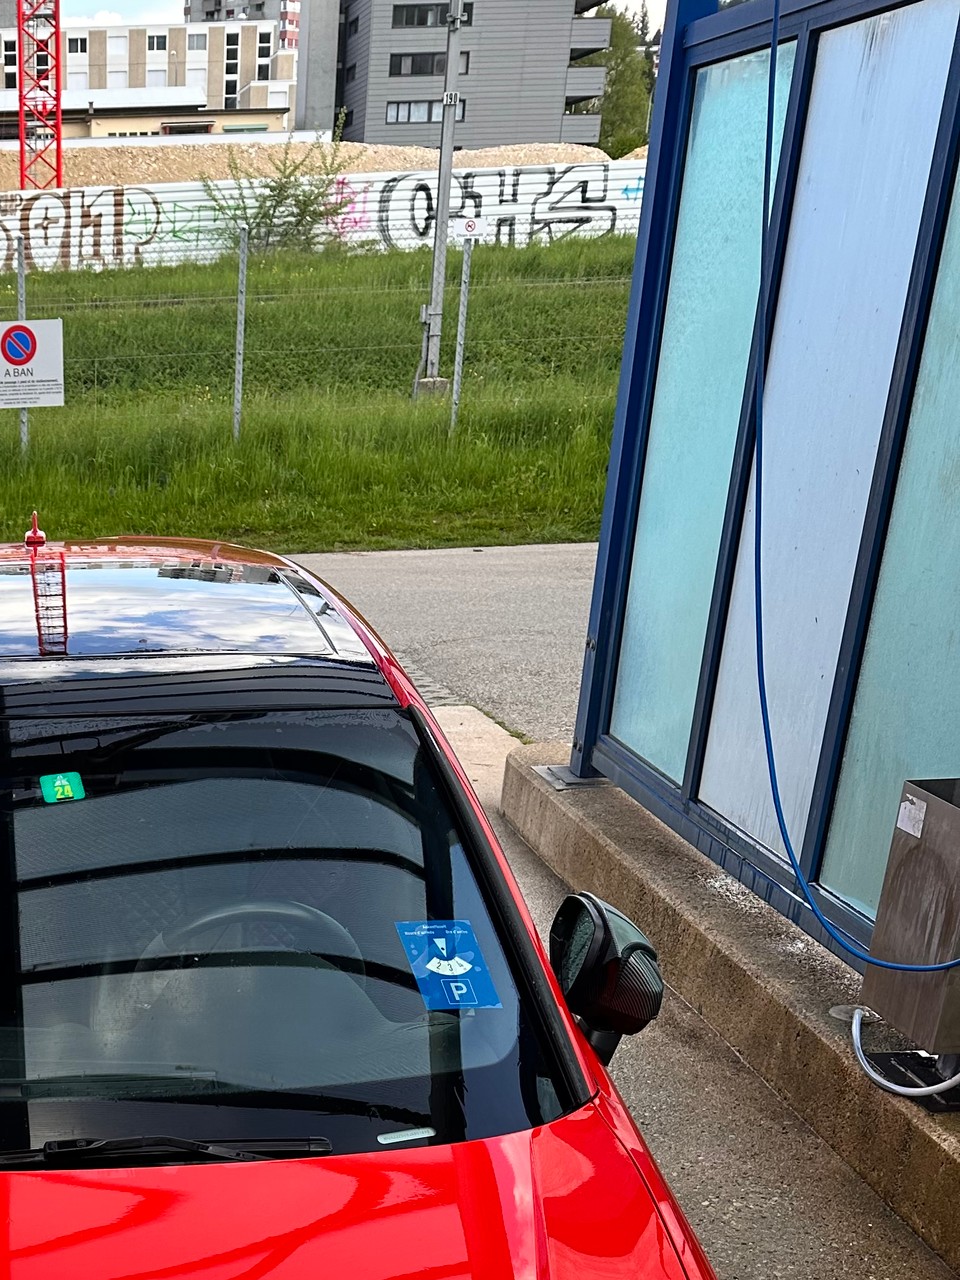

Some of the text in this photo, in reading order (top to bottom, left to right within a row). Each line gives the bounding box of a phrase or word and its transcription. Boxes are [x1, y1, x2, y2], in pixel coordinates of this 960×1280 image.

[4, 367, 34, 378] A BAN
[54, 785, 74, 798] 24
[436, 961, 442, 970] 2
[447, 963, 454, 972] 3
[450, 982, 468, 1001] P
